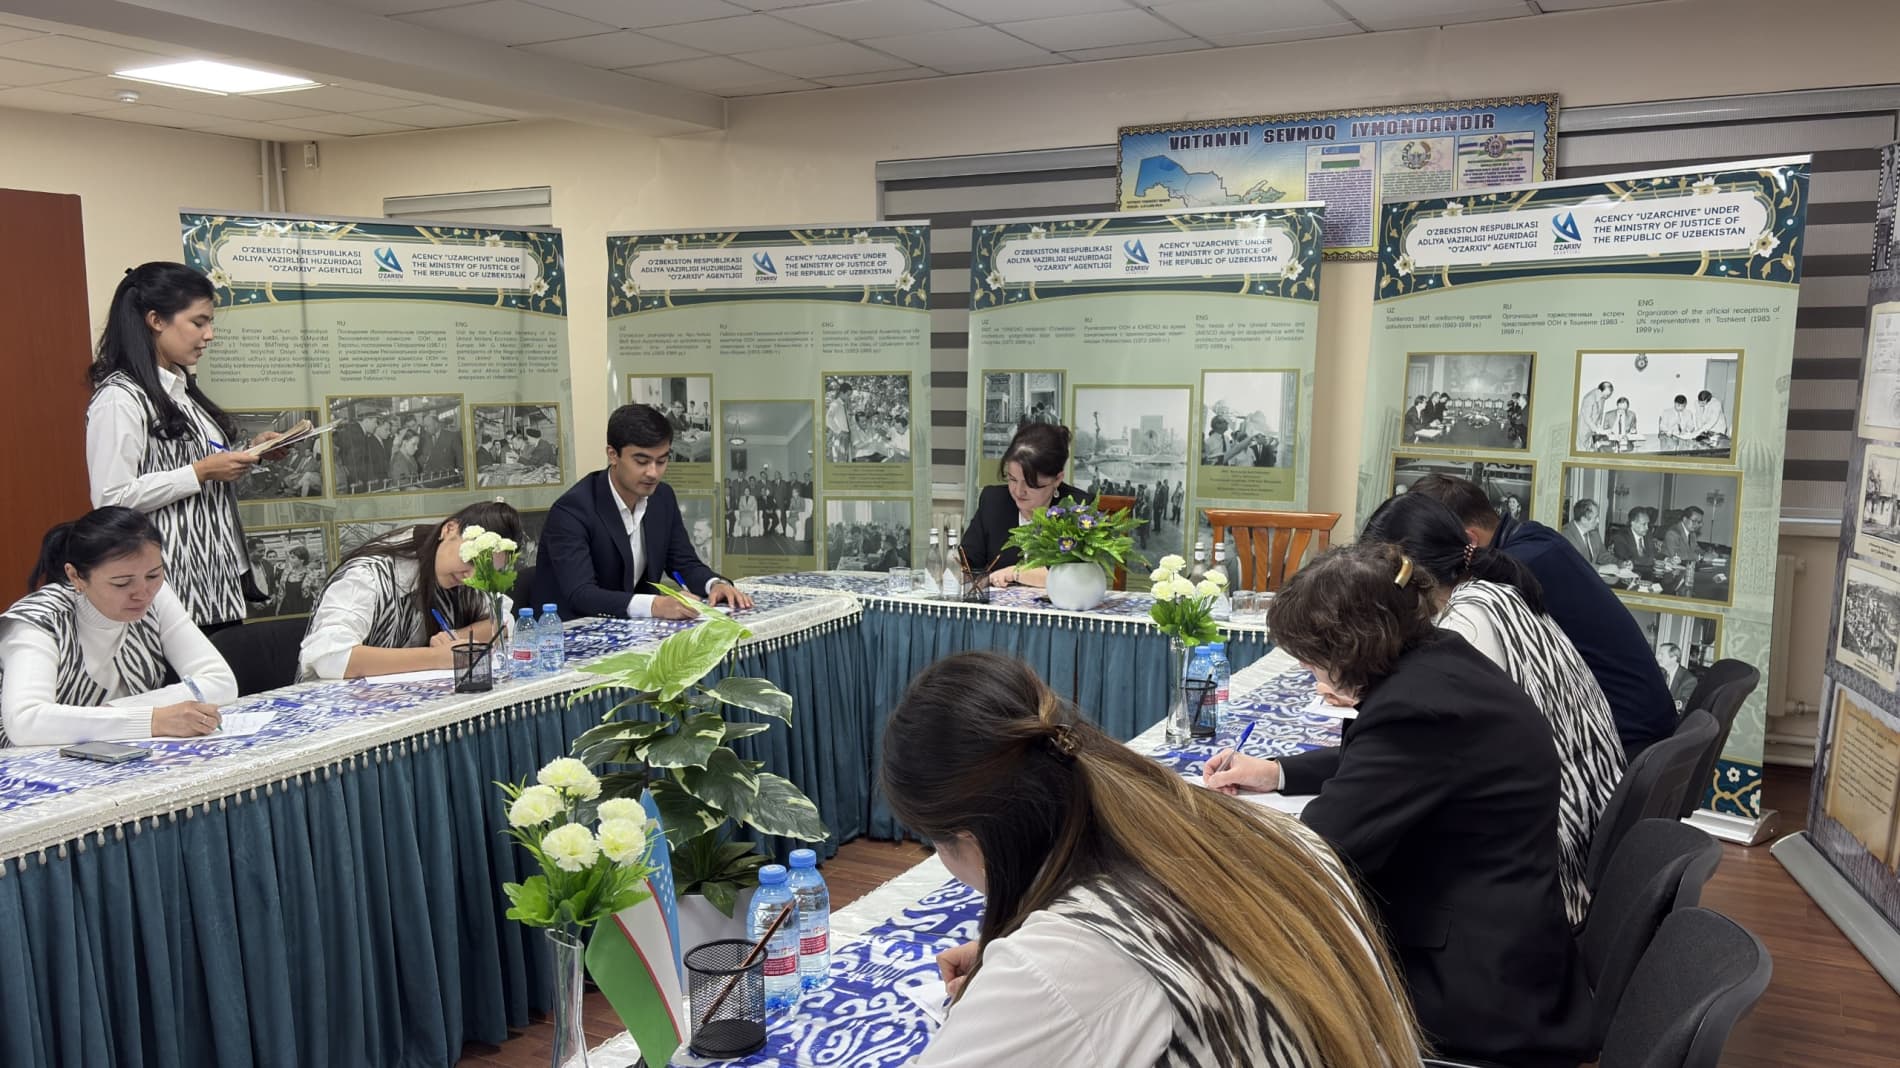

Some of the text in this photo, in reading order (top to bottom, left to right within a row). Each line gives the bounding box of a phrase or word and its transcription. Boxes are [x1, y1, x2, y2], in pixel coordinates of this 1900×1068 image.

[1169, 113, 1495, 150] VATANNI SEVMOQ IYMONDANDIR
[1636, 208, 1701, 221] "UZARCHIVE"
[1704, 205, 1740, 215] UNDER
[1427, 221, 1539, 236] O'ZBEKISTON RESPUBLIKASI
[1614, 222, 1661, 232] MINISTRY
[1664, 221, 1677, 229] OF
[1680, 218, 1721, 227] JUSTICE
[1725, 216, 1740, 224] OF
[1418, 231, 1538, 246] ADLIYA VAZIRLIGI HUZURIDAGI
[1593, 236, 1611, 244] THE
[1613, 233, 1662, 242] REPUBLIC
[1682, 227, 1745, 238] UZBEKISTAN
[301, 249, 361, 257] RESPUBLIKASI
[1061, 246, 1112, 254] RESPUBLIKASI
[1448, 241, 1537, 253] "O'ZARXIV" AGENTLIGI
[266, 256, 308, 264] VAZIRLIGI
[311, 258, 362, 266] HUZURIDAGI
[445, 254, 493, 262] "UZARCHIVE"
[1068, 254, 1111, 262] HUZURIDAGI
[1229, 256, 1278, 264] UZBEKISTAN
